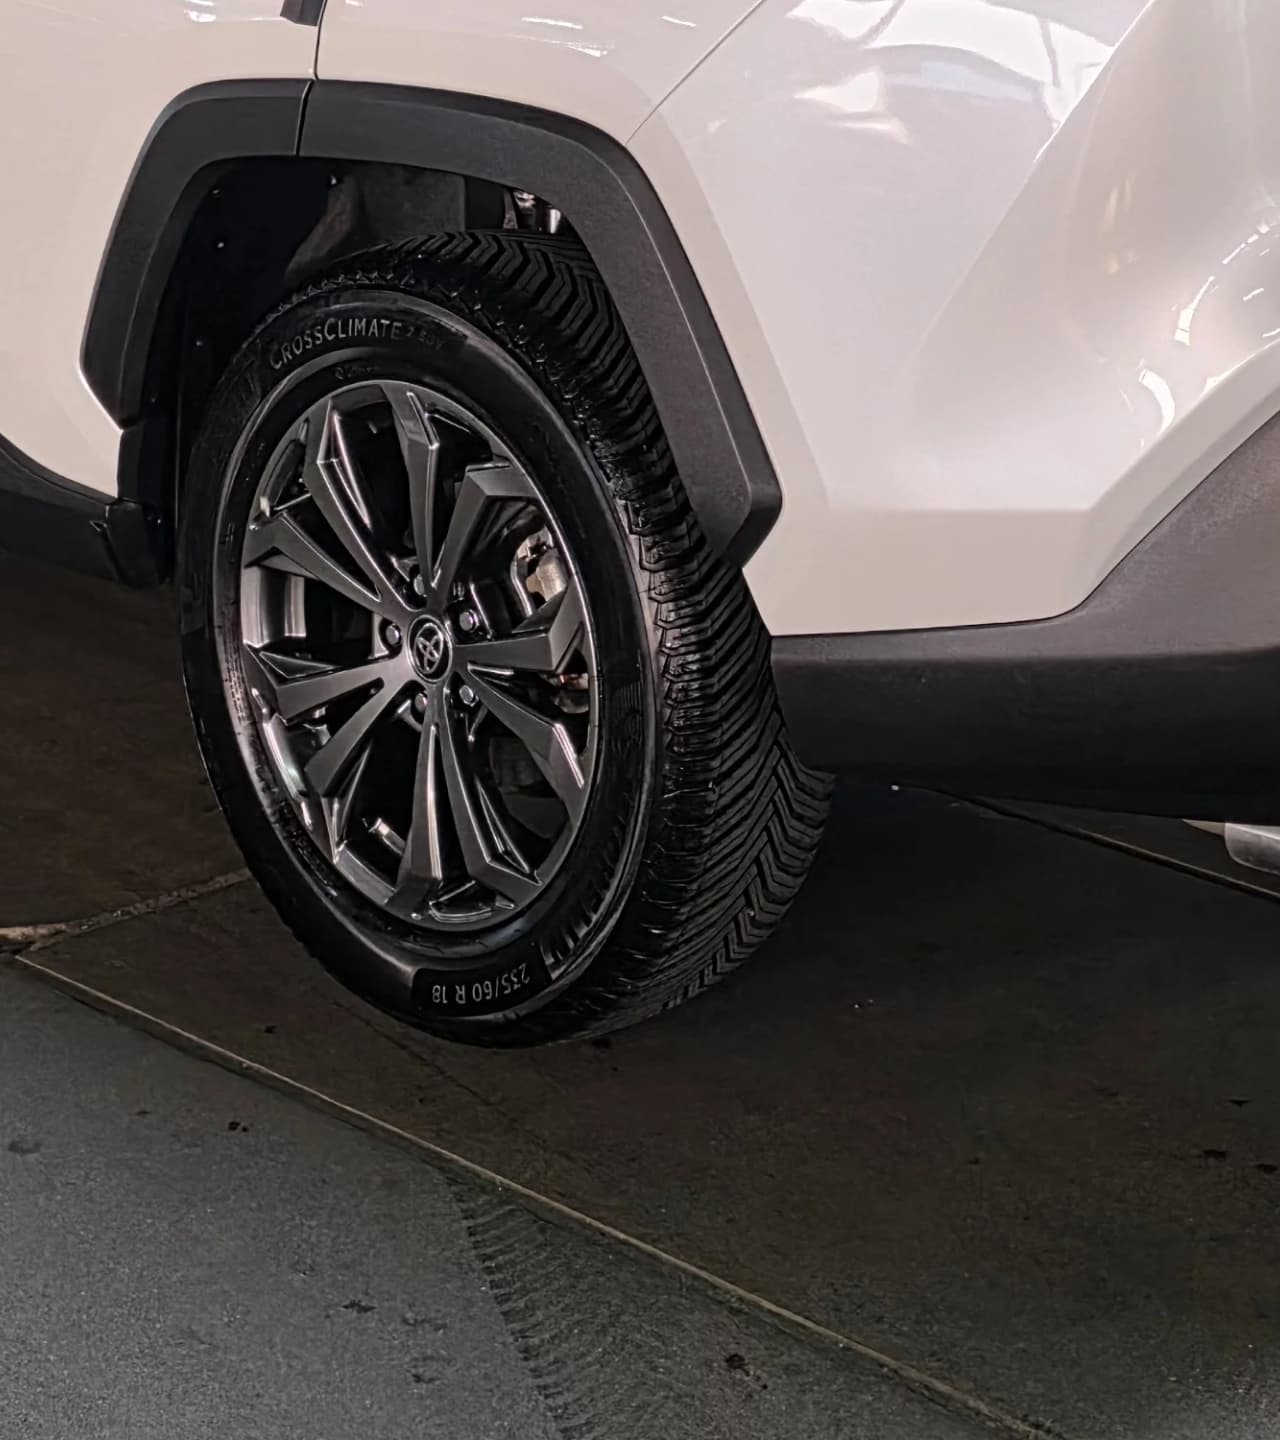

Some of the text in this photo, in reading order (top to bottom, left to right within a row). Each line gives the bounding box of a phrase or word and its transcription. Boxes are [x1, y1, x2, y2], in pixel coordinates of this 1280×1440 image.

[431, 962, 531, 1005] 235/60 R 18
